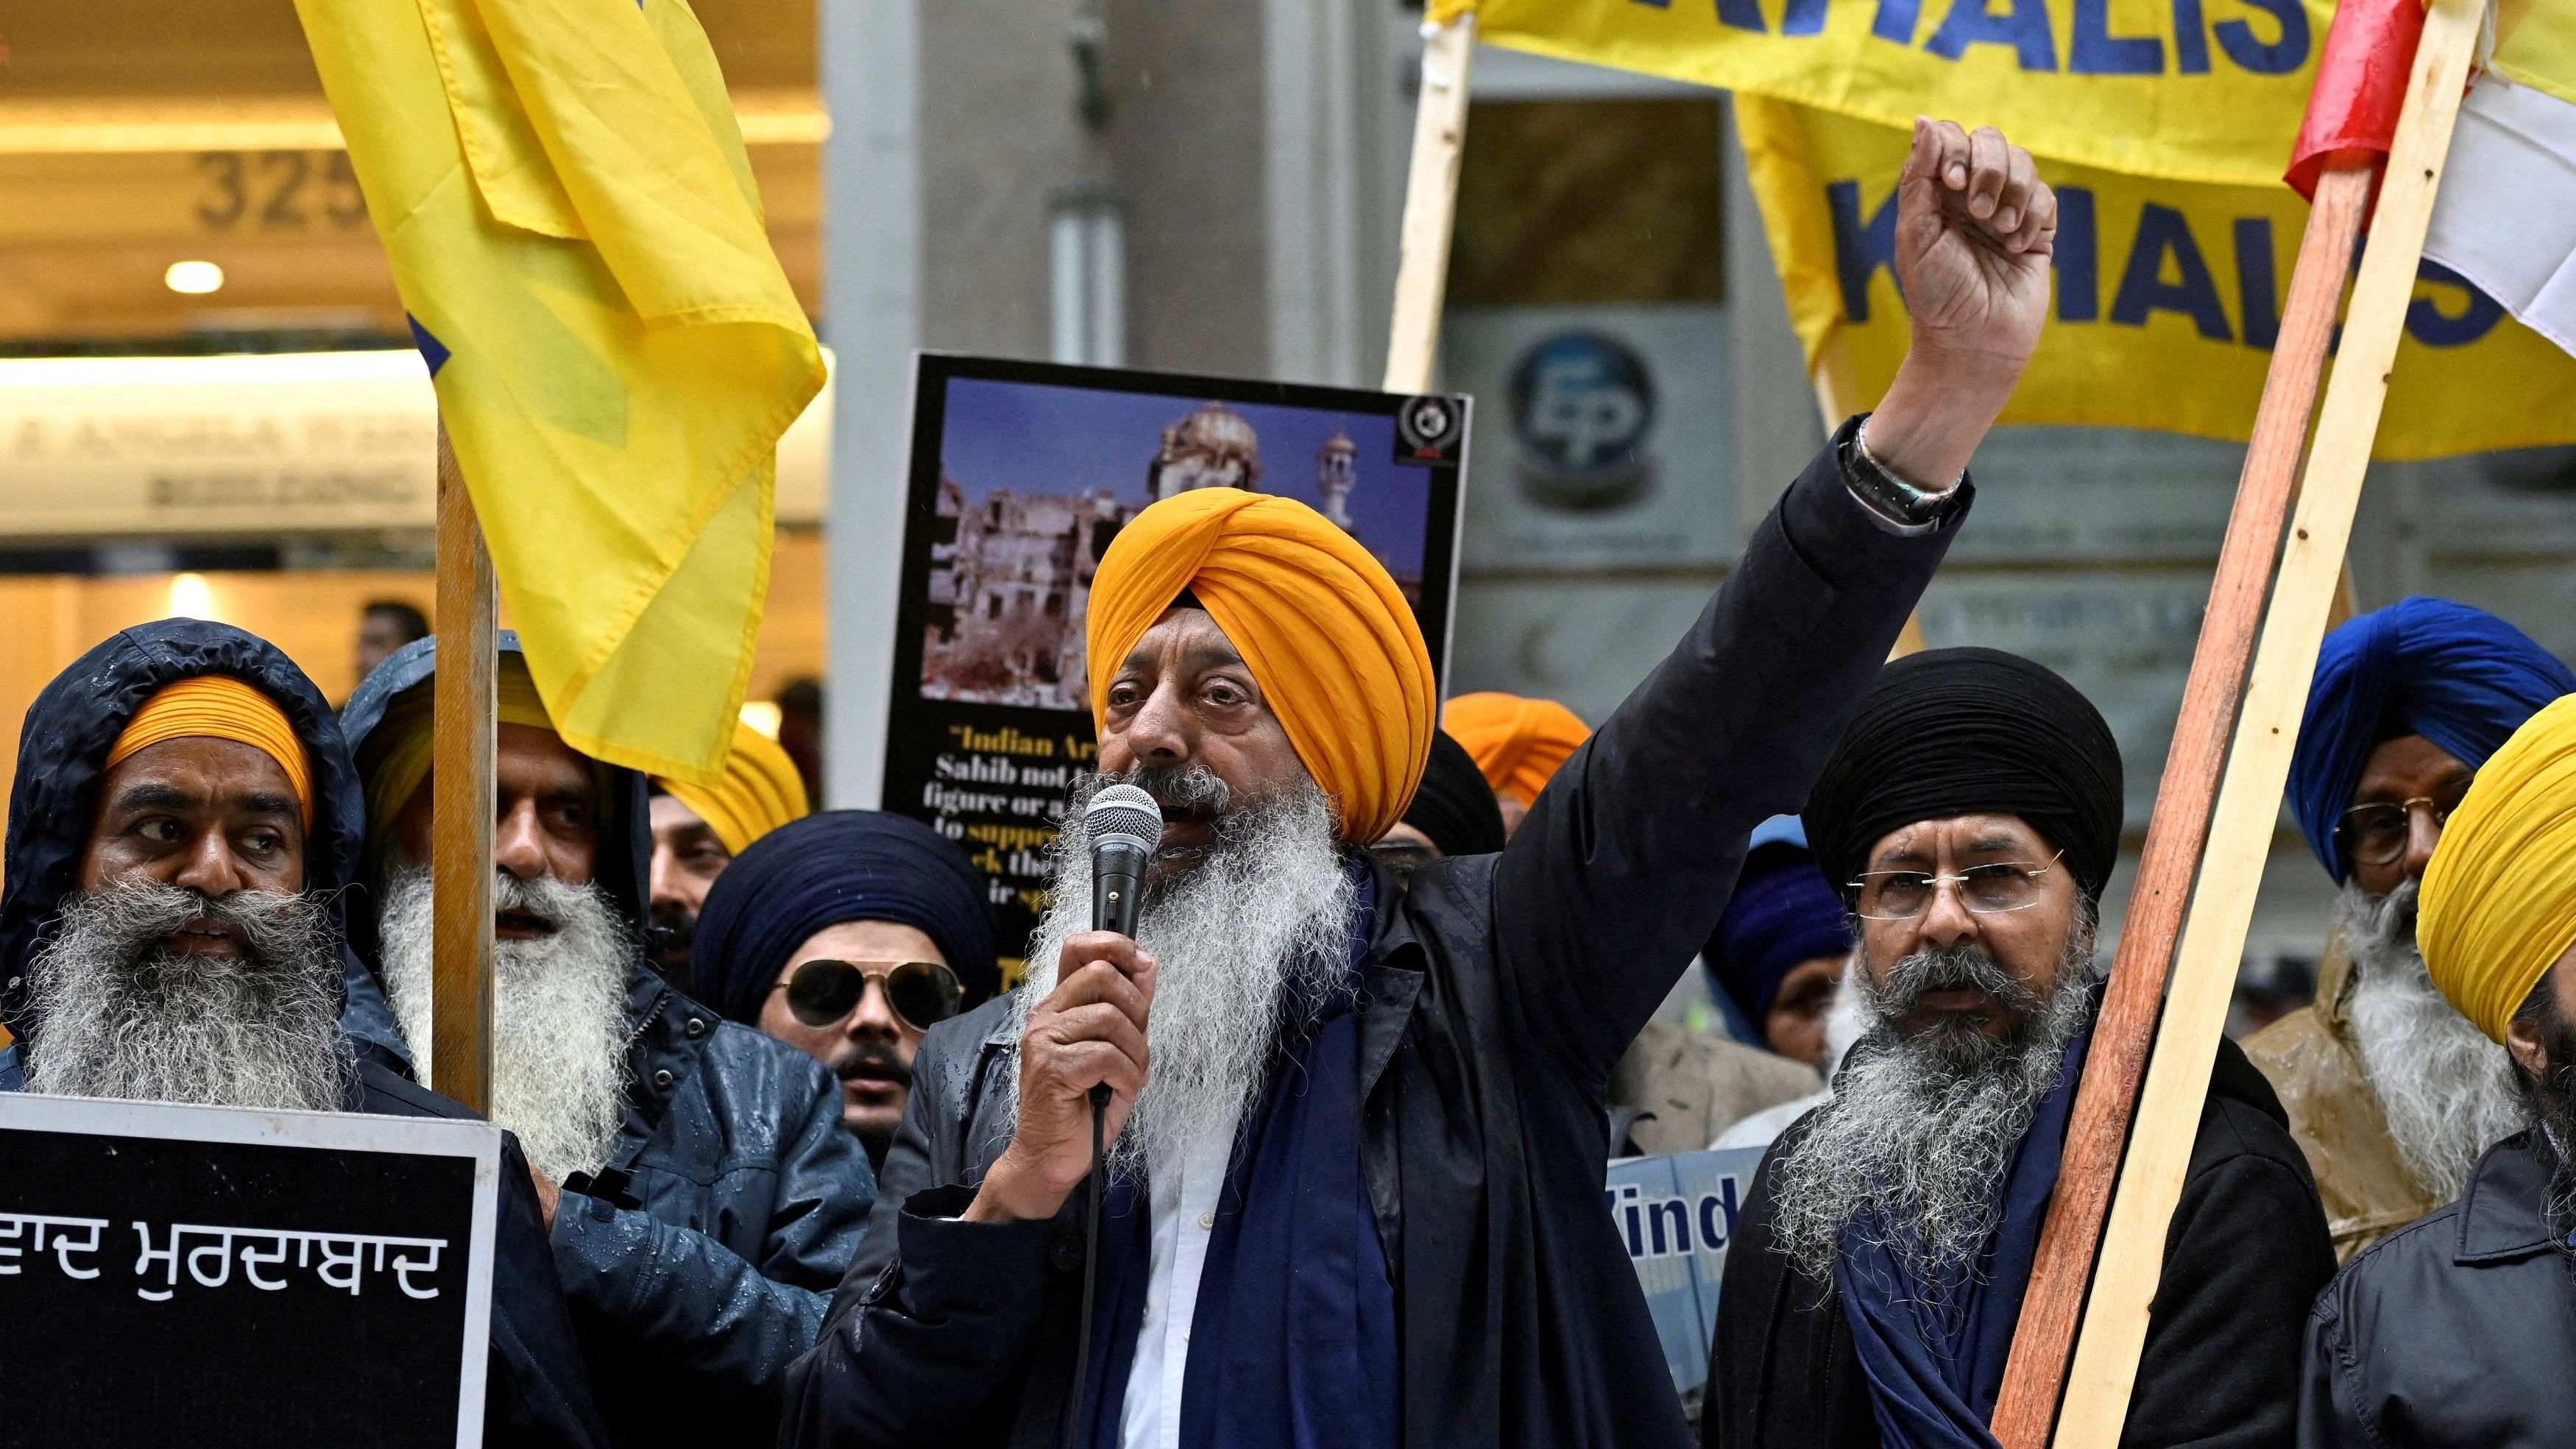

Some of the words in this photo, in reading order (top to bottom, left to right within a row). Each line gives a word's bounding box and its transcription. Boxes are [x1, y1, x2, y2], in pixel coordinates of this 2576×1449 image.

[935, 752, 1018, 784] Sahib
[1022, 765, 1066, 790] not
[922, 780, 1008, 818] figure
[1011, 796, 1047, 816] or
[1100, 843, 1129, 851] SHURE
[132, 1221, 447, 1301] ਮੁਰਦਾਬਾਦ
